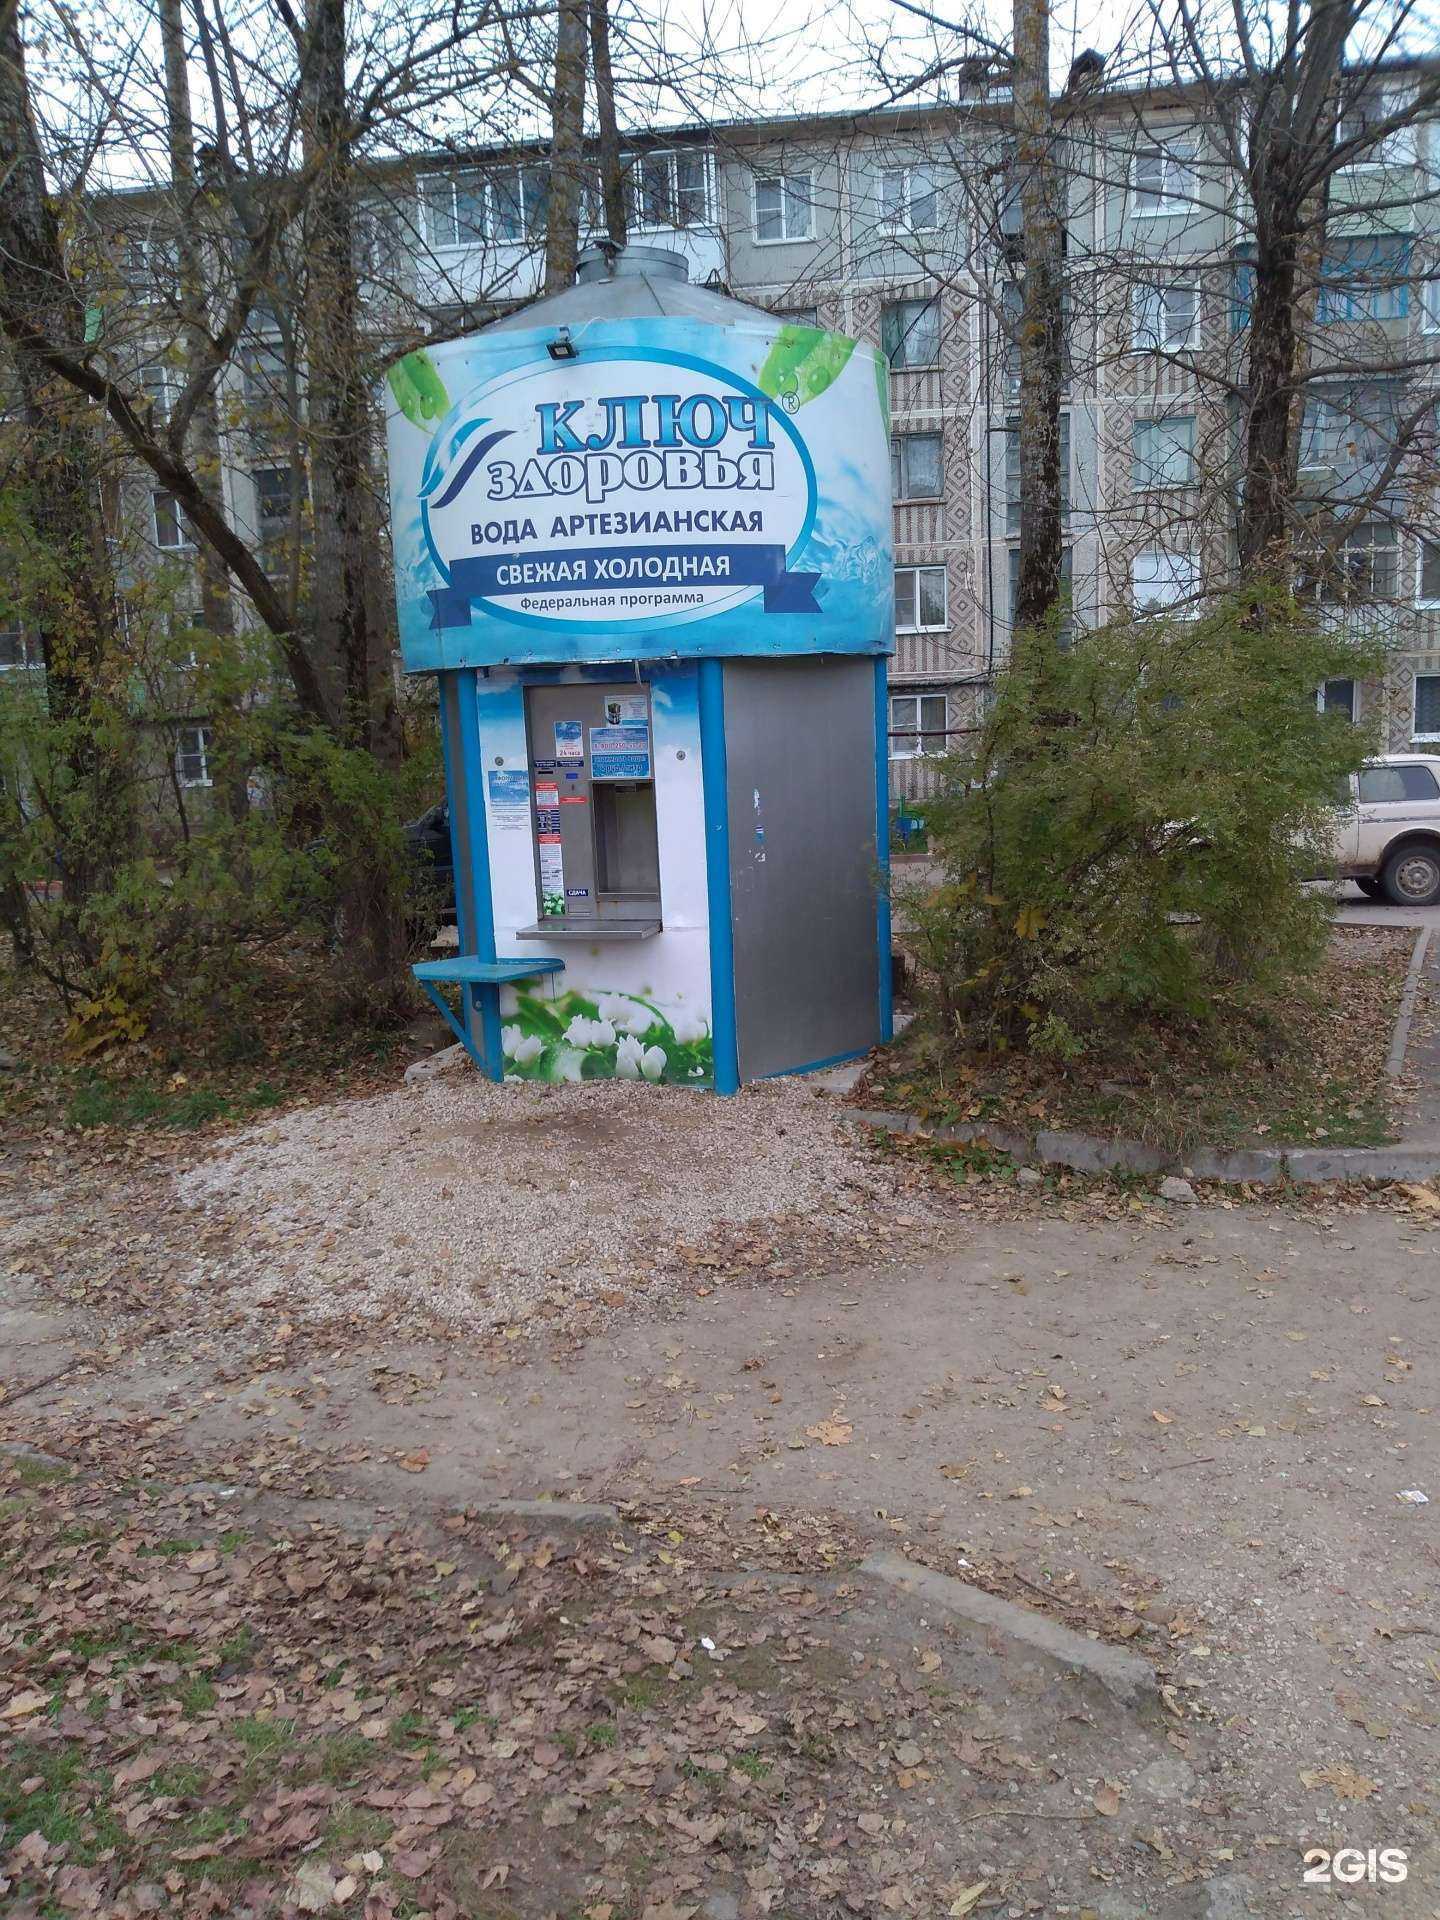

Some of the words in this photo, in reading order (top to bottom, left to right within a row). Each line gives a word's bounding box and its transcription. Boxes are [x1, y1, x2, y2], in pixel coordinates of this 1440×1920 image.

[535, 393, 776, 456] КЛЮЧ
[470, 518, 538, 545] ВОДА
[550, 509, 764, 538] АРТЕЗИАНСКАЯ
[496, 559, 587, 586] СВЕЖАЯ
[594, 555, 731, 582] ХОЛОДНАЯ
[520, 595, 616, 612] Федеральная
[620, 592, 704, 607] программа
